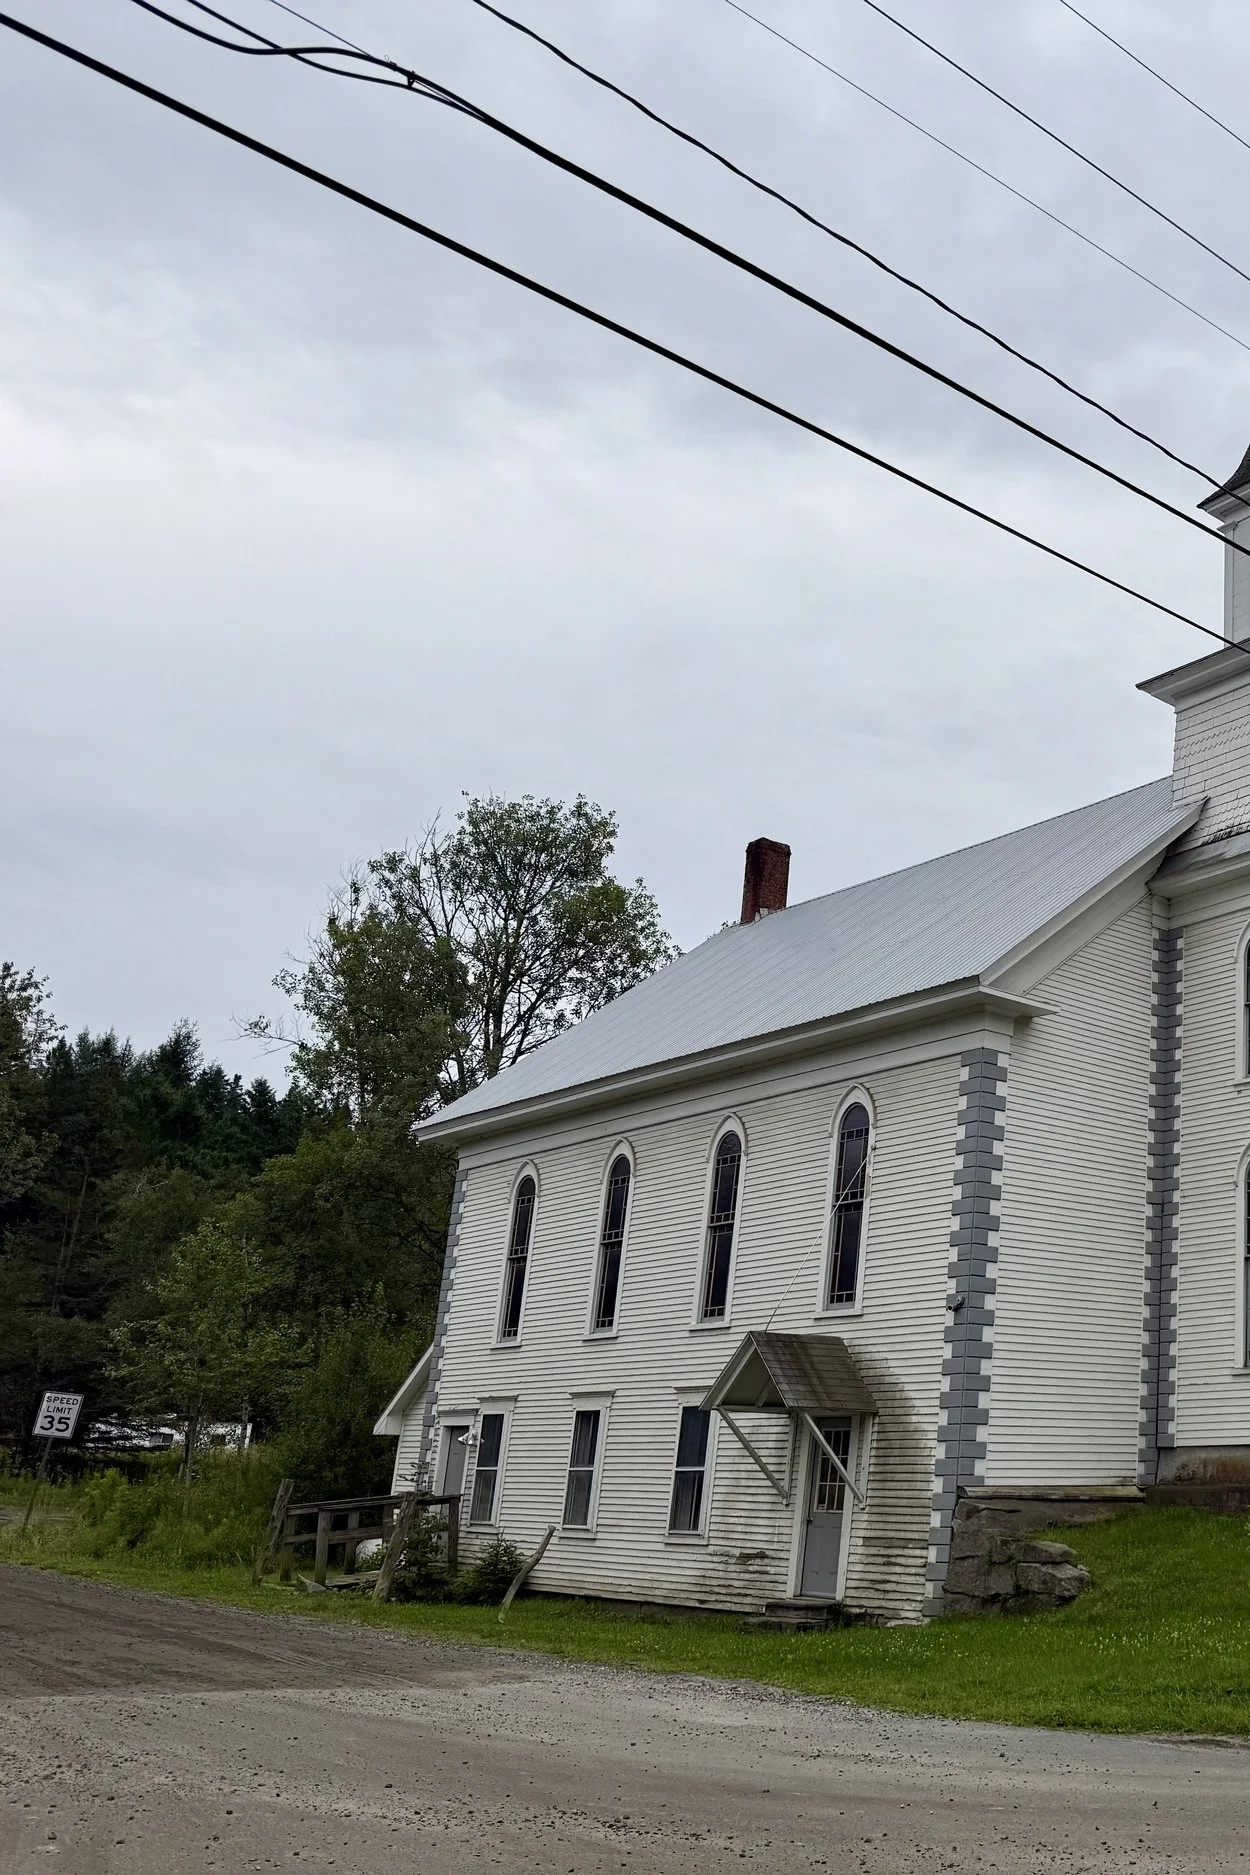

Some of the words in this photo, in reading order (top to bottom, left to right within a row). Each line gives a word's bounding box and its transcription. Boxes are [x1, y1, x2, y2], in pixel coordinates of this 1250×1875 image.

[46, 1396, 79, 1405] SPEED
[46, 1406, 73, 1415] LIMIT
[40, 1415, 71, 1432] 35
